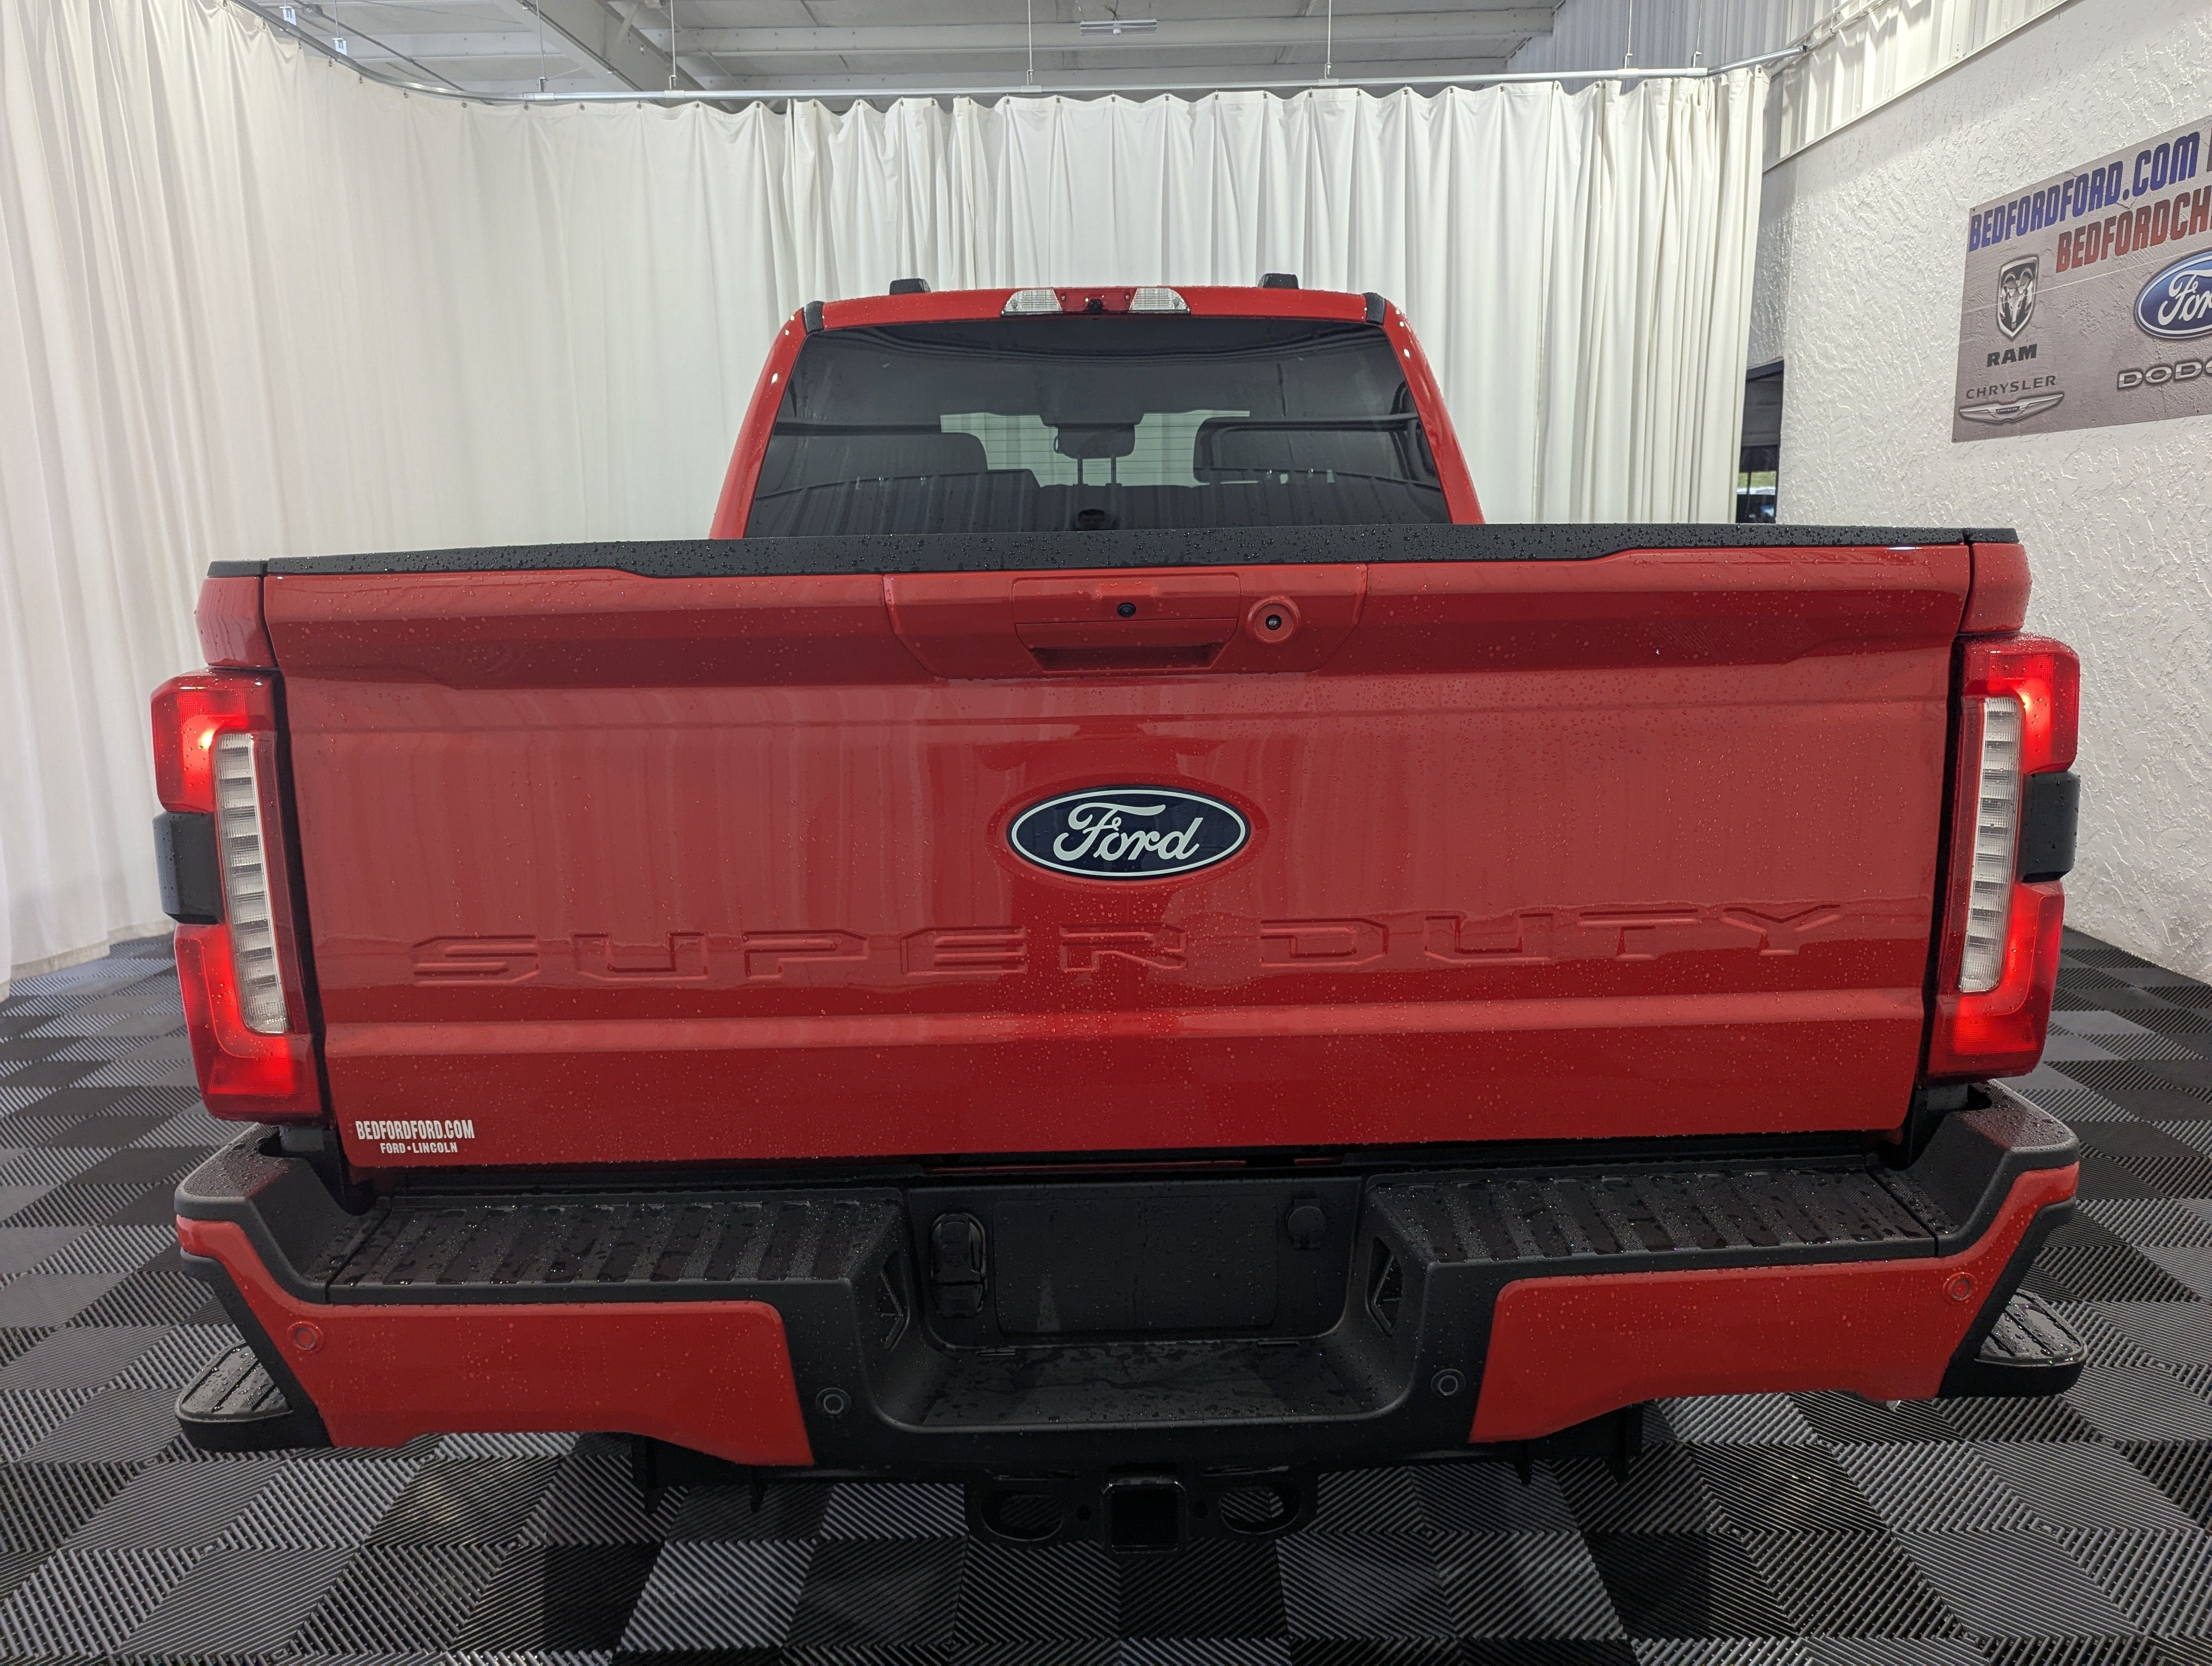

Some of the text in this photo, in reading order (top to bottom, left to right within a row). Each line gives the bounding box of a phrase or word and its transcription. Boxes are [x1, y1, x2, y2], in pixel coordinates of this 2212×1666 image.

[1968, 131, 2201, 253] BEDFORDFORD.COM
[2055, 185, 2212, 273] BEDFORDCH
[1986, 343, 2037, 368] RAM
[1966, 375, 2056, 399] CHRYSLER
[1053, 802, 1204, 861] Ford
[412, 903, 1842, 987] SUPER DUTY
[355, 1119, 475, 1140] BEDFORDFORD.COM
